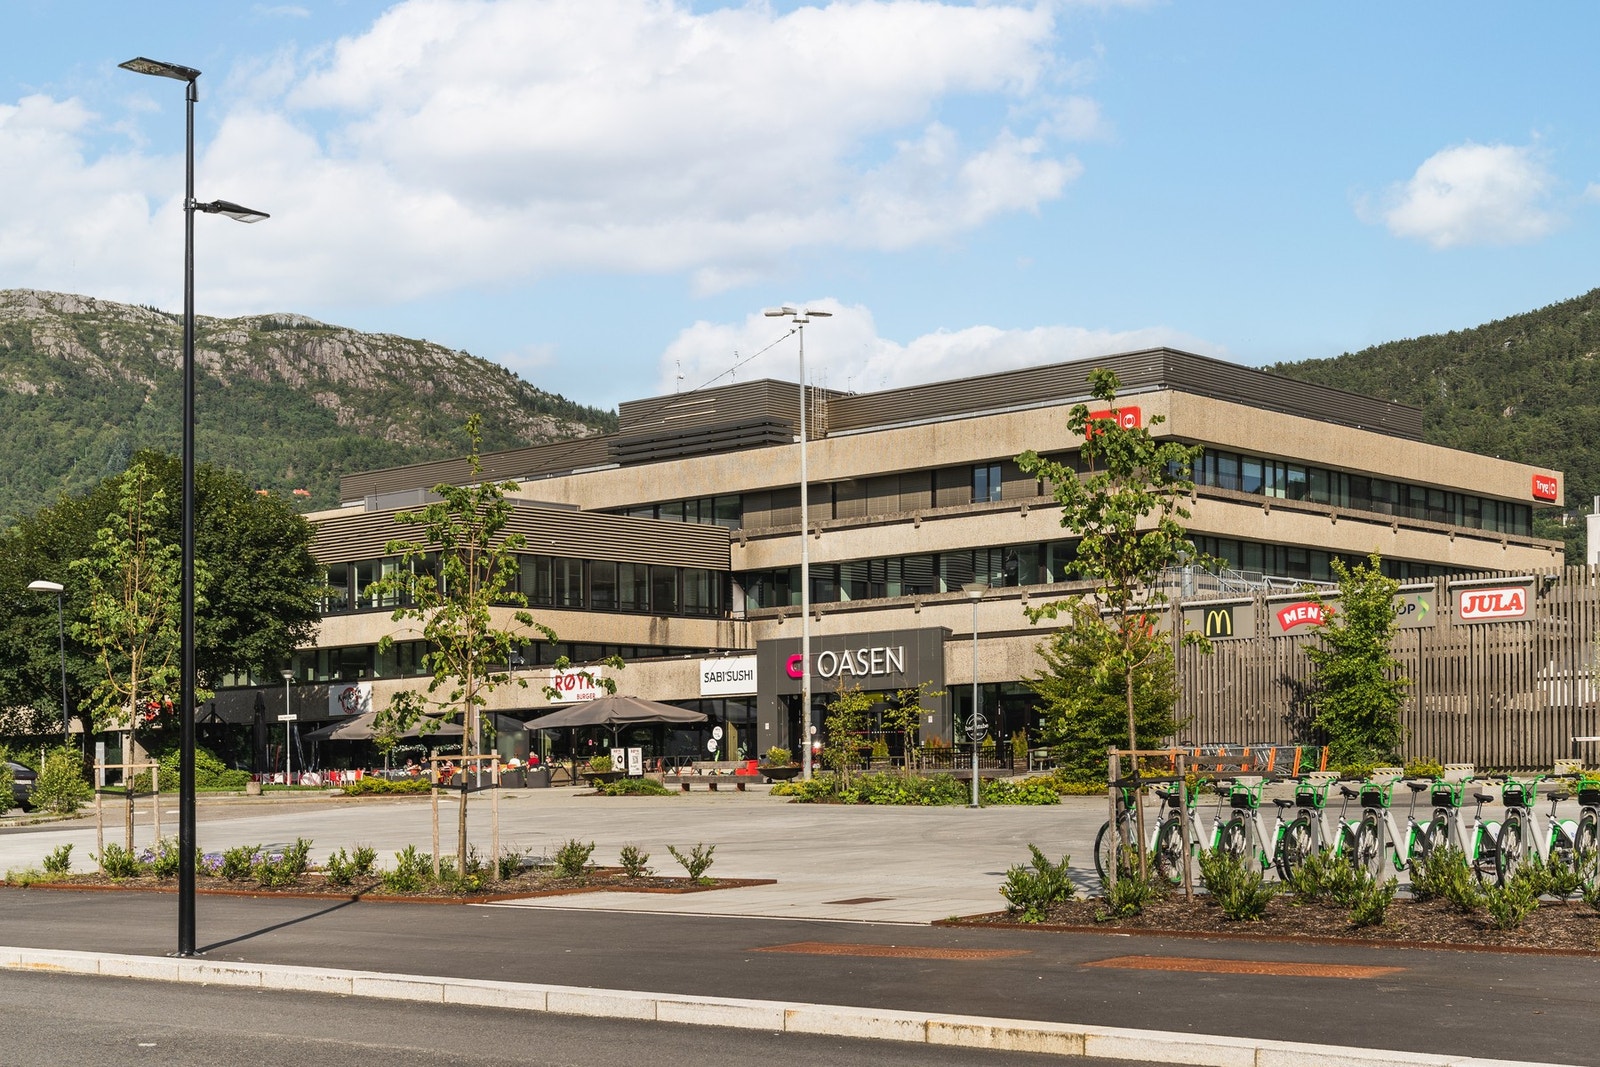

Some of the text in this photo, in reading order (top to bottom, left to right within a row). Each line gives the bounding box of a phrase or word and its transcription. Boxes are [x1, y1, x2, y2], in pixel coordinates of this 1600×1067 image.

[1463, 592, 1524, 613] JULA
[817, 646, 904, 678] OASEN
[576, 692, 596, 700] BURGER
